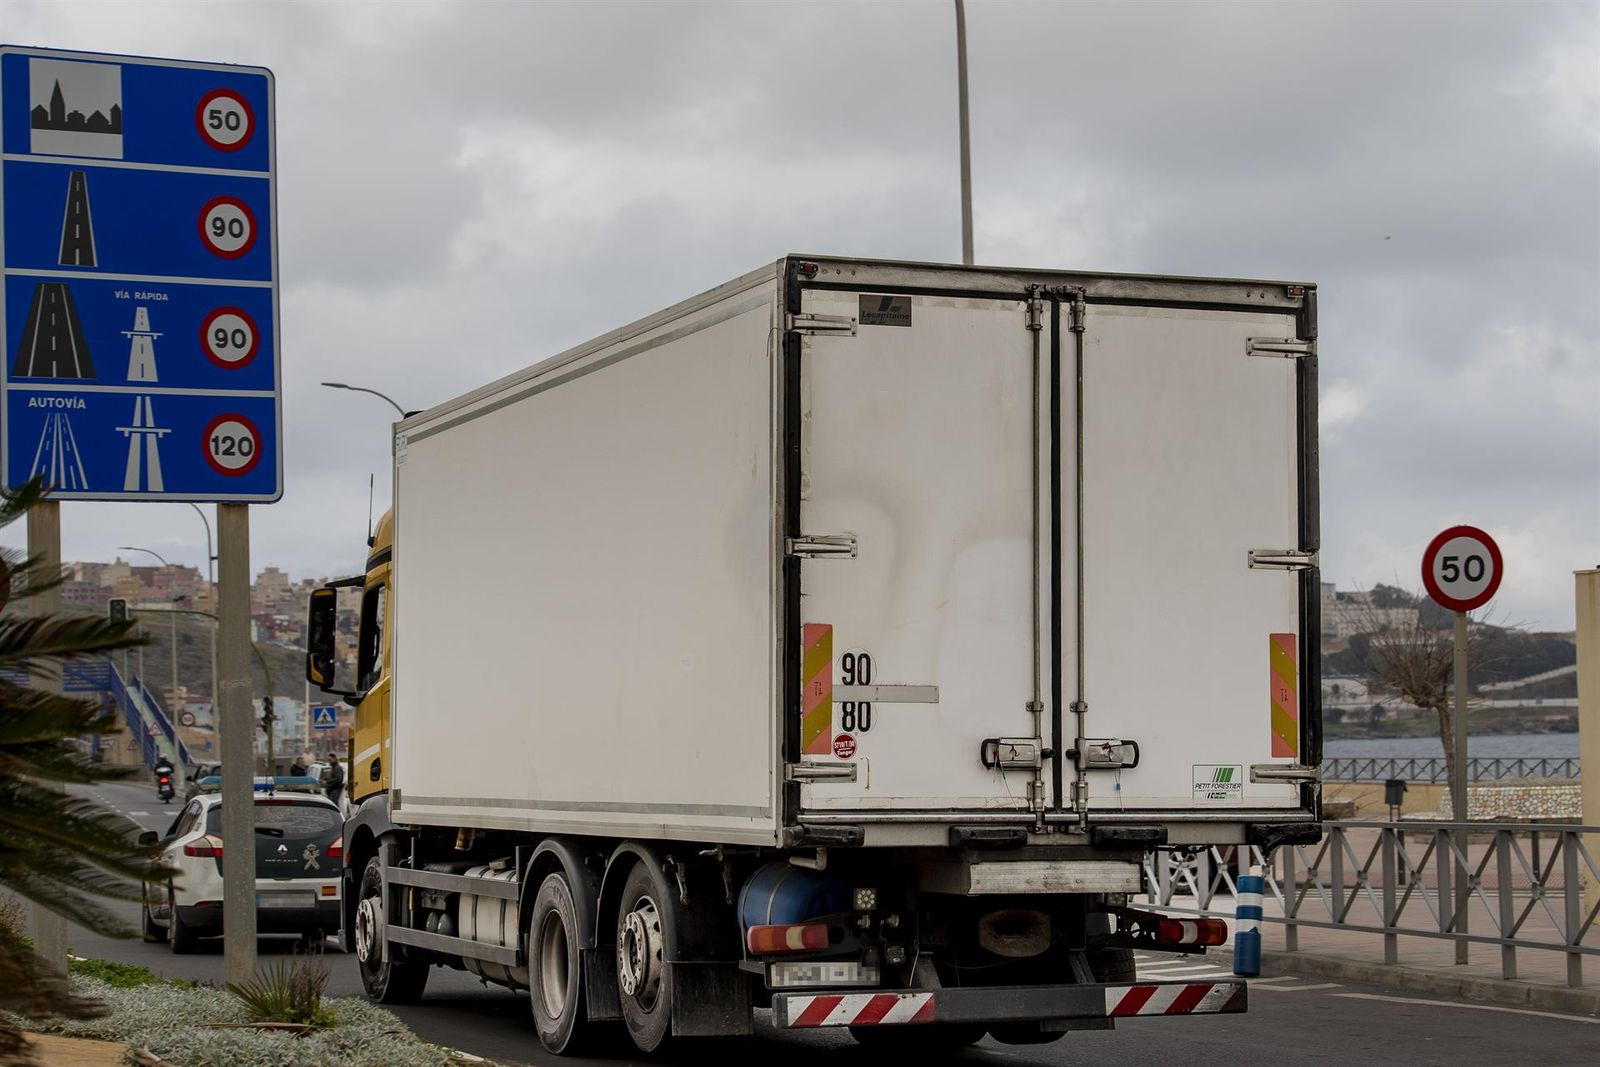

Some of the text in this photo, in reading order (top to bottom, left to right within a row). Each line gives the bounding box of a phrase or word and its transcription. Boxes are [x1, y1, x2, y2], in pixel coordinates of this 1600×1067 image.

[208, 109, 241, 131] 50
[211, 216, 244, 239] 90
[114, 290, 169, 301] VÍA RÁPIDA
[214, 328, 247, 349] 90
[28, 397, 87, 409] AUTOVÍA
[211, 435, 253, 457] 120
[1441, 554, 1485, 583] 50
[842, 652, 871, 686] 90
[842, 701, 871, 732] 80
